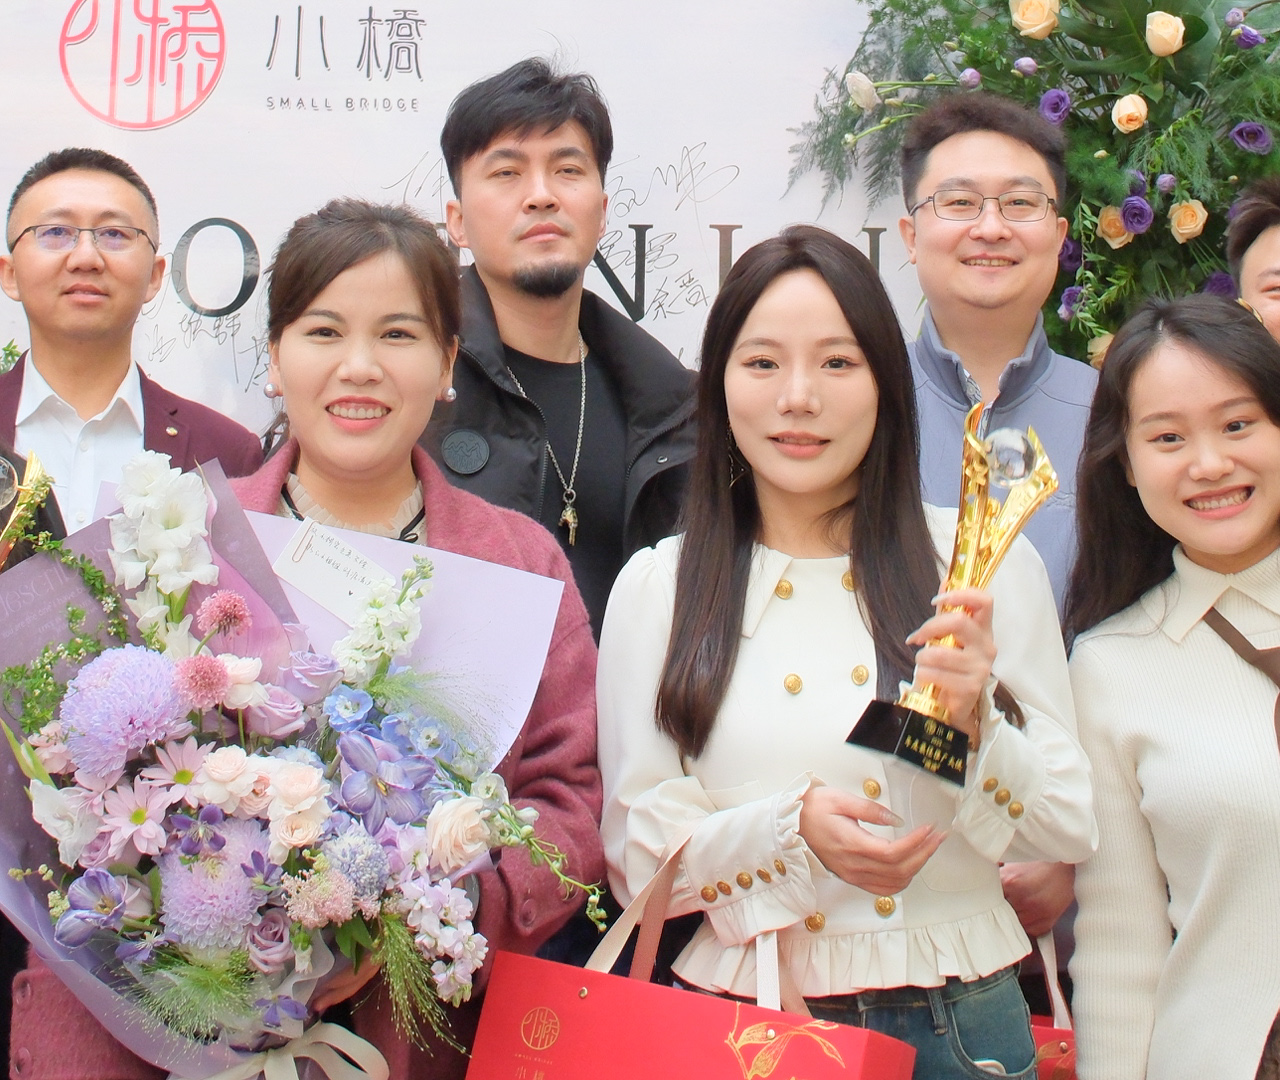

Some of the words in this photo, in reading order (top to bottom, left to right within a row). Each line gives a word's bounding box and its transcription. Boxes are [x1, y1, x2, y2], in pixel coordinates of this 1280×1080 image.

[266, 5, 426, 80] 小橋
[266, 96, 332, 110] SMALL
[345, 97, 422, 111] BRIDGE
